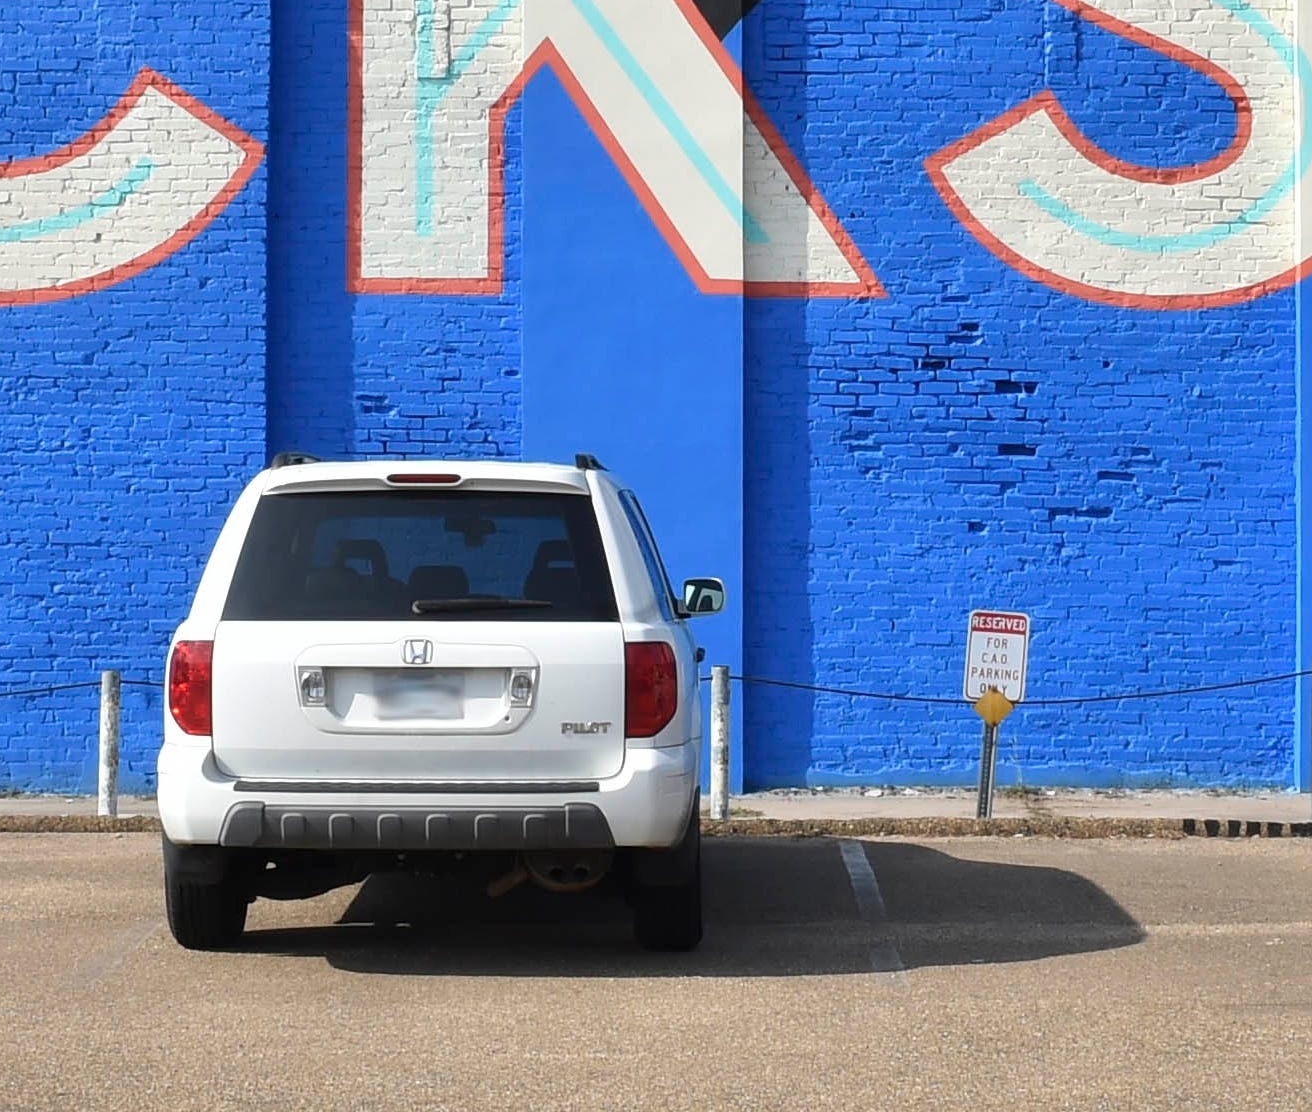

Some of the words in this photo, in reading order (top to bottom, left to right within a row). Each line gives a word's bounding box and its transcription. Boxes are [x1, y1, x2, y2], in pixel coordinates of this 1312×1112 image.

[972, 616, 1026, 631] RESERVED
[987, 637, 1008, 648] FOR
[971, 667, 1019, 680] PARKING
[561, 721, 612, 734] PILOT
